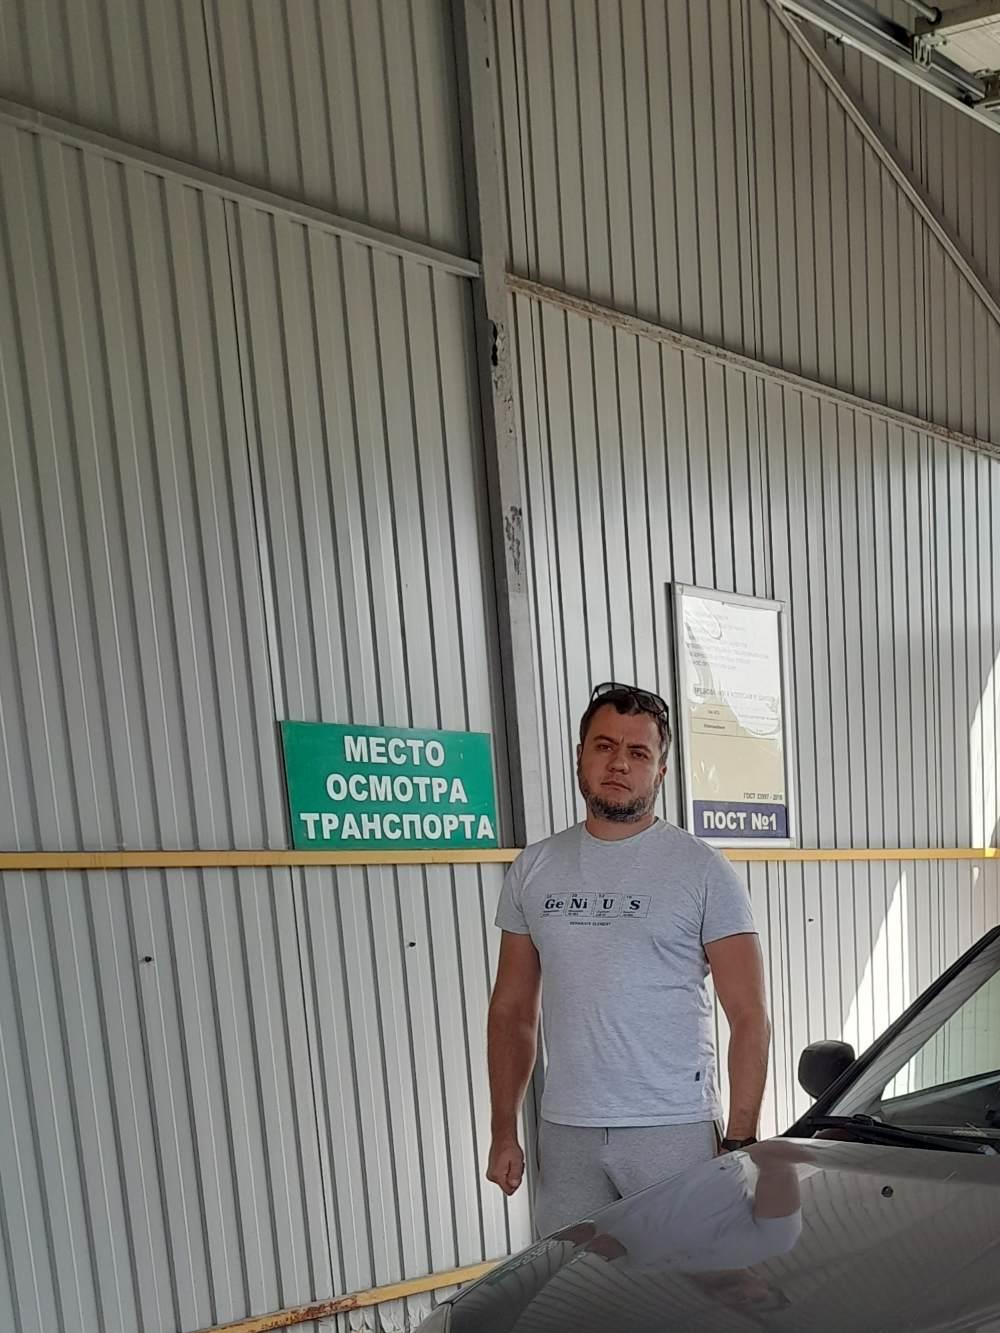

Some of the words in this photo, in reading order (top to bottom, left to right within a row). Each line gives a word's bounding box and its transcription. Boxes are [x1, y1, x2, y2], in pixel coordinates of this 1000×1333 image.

[343, 735, 445, 767] МЕСТО
[326, 773, 468, 803] ОСМОТРА
[300, 812, 495, 840] ТРАНСПОРТА
[703, 810, 747, 830] ПОСТ
[751, 812, 777, 831] №1
